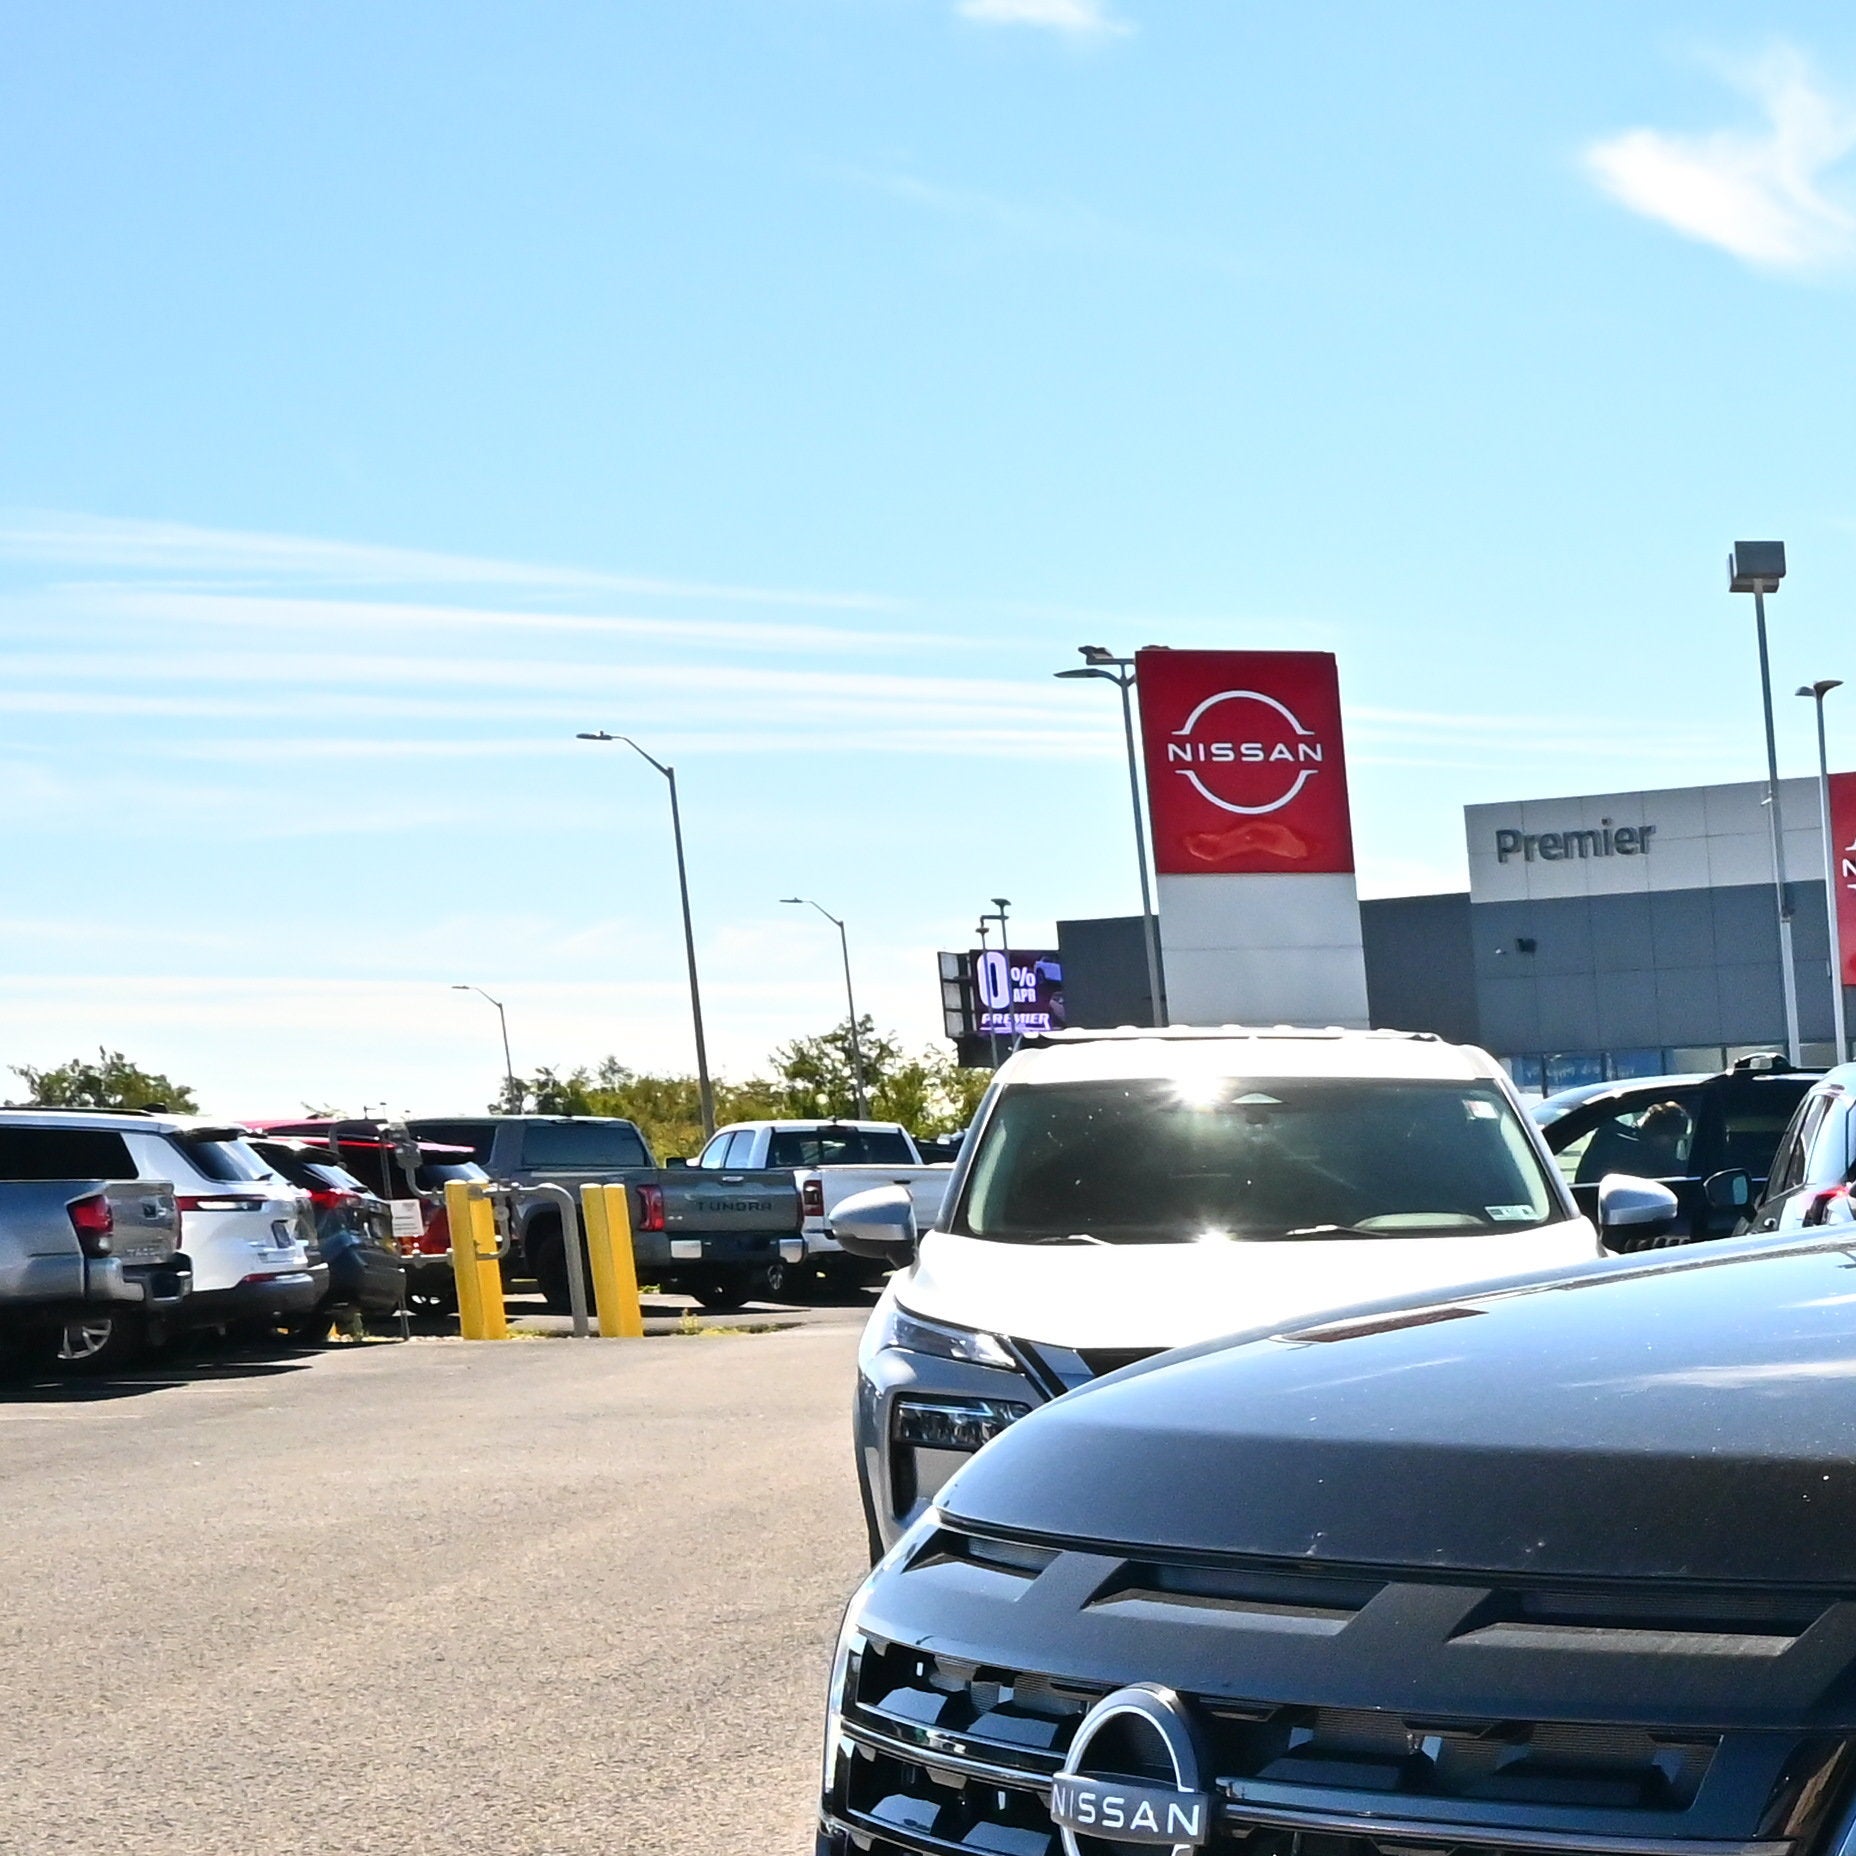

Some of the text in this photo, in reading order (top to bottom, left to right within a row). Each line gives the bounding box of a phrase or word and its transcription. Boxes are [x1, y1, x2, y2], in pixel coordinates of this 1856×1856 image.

[1167, 742, 1323, 763] NISSAN
[1495, 816, 1657, 864] Premier
[981, 1012, 1052, 1031] PREMIER
[698, 1200, 772, 1212] TUNDRA
[1051, 1783, 1200, 1836] NISSAN
